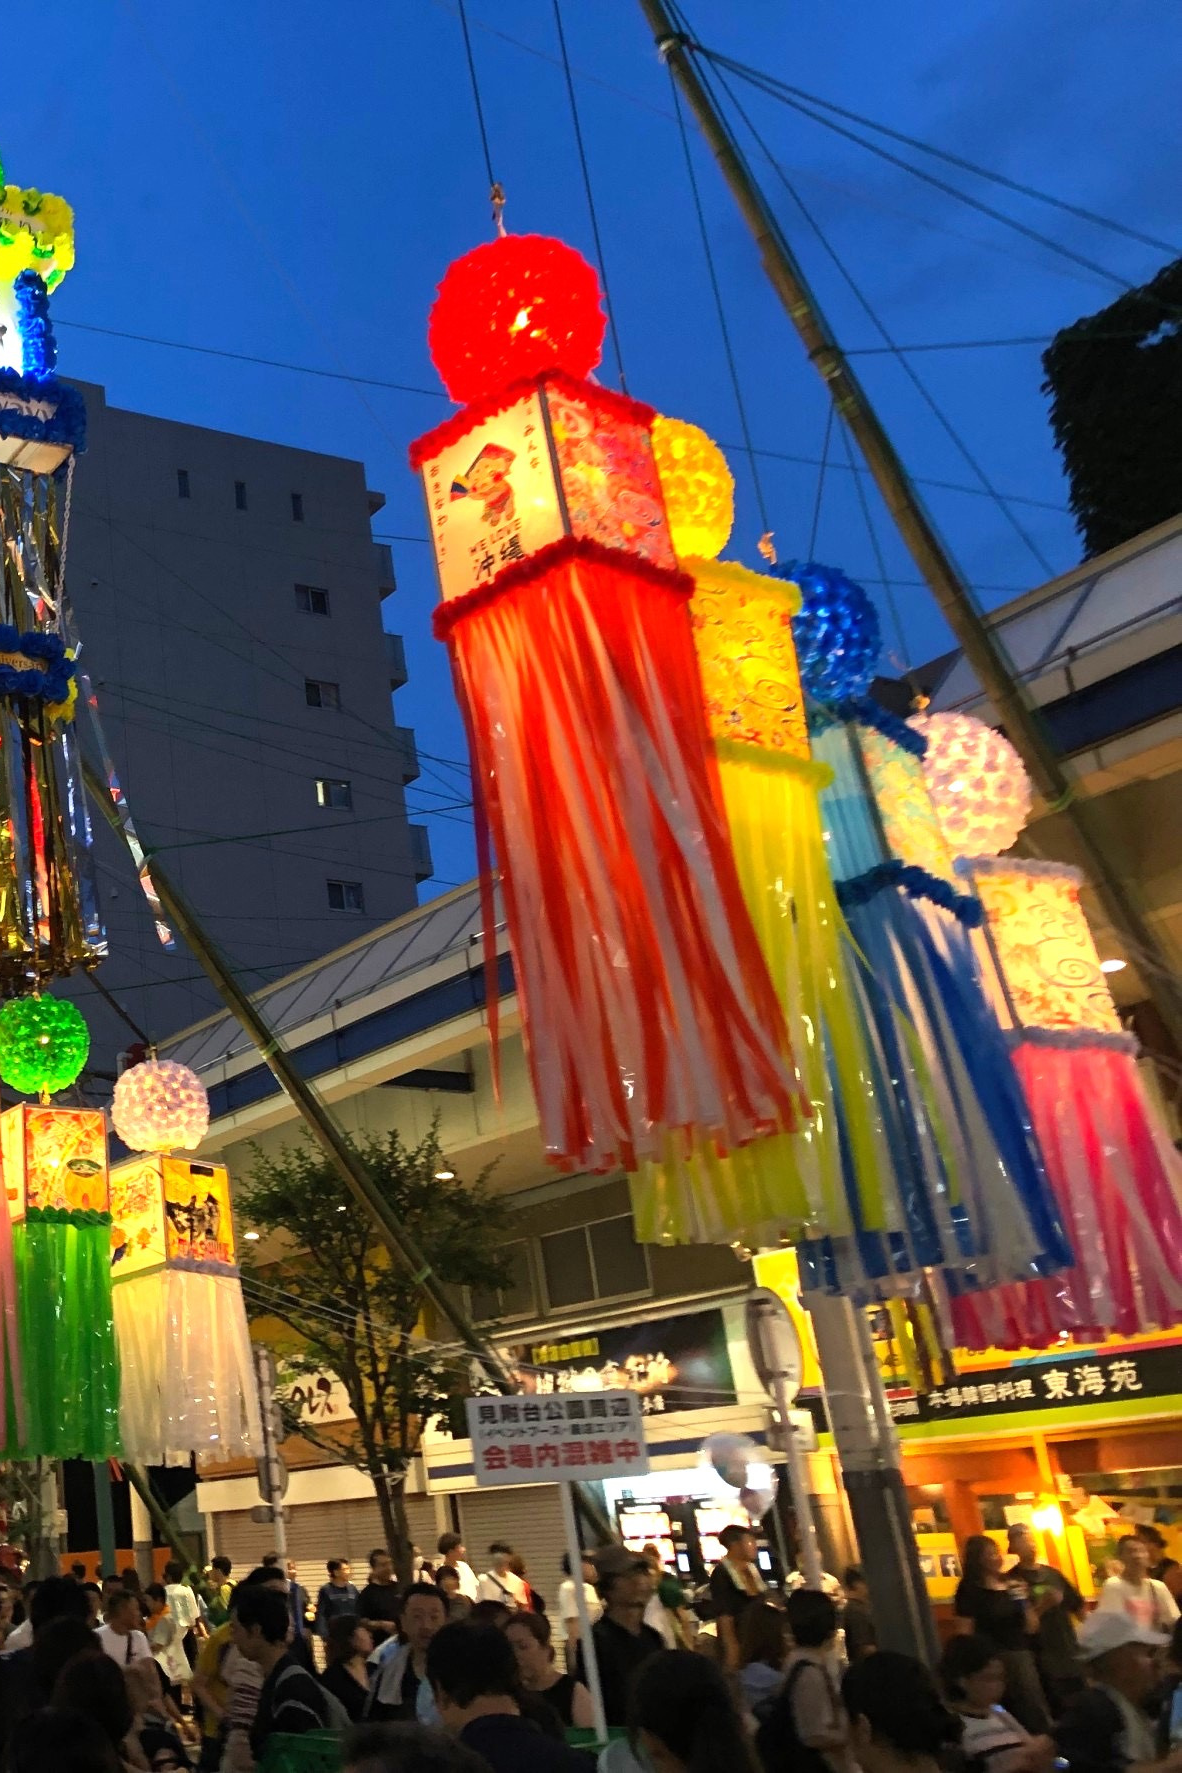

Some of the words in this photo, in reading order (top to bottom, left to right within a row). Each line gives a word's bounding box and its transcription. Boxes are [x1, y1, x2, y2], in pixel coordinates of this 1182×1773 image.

[475, 533, 525, 581] 沖縄
[1042, 1360, 1143, 1400] 東海苑
[482, 1439, 640, 1470] 会場内混雑中
